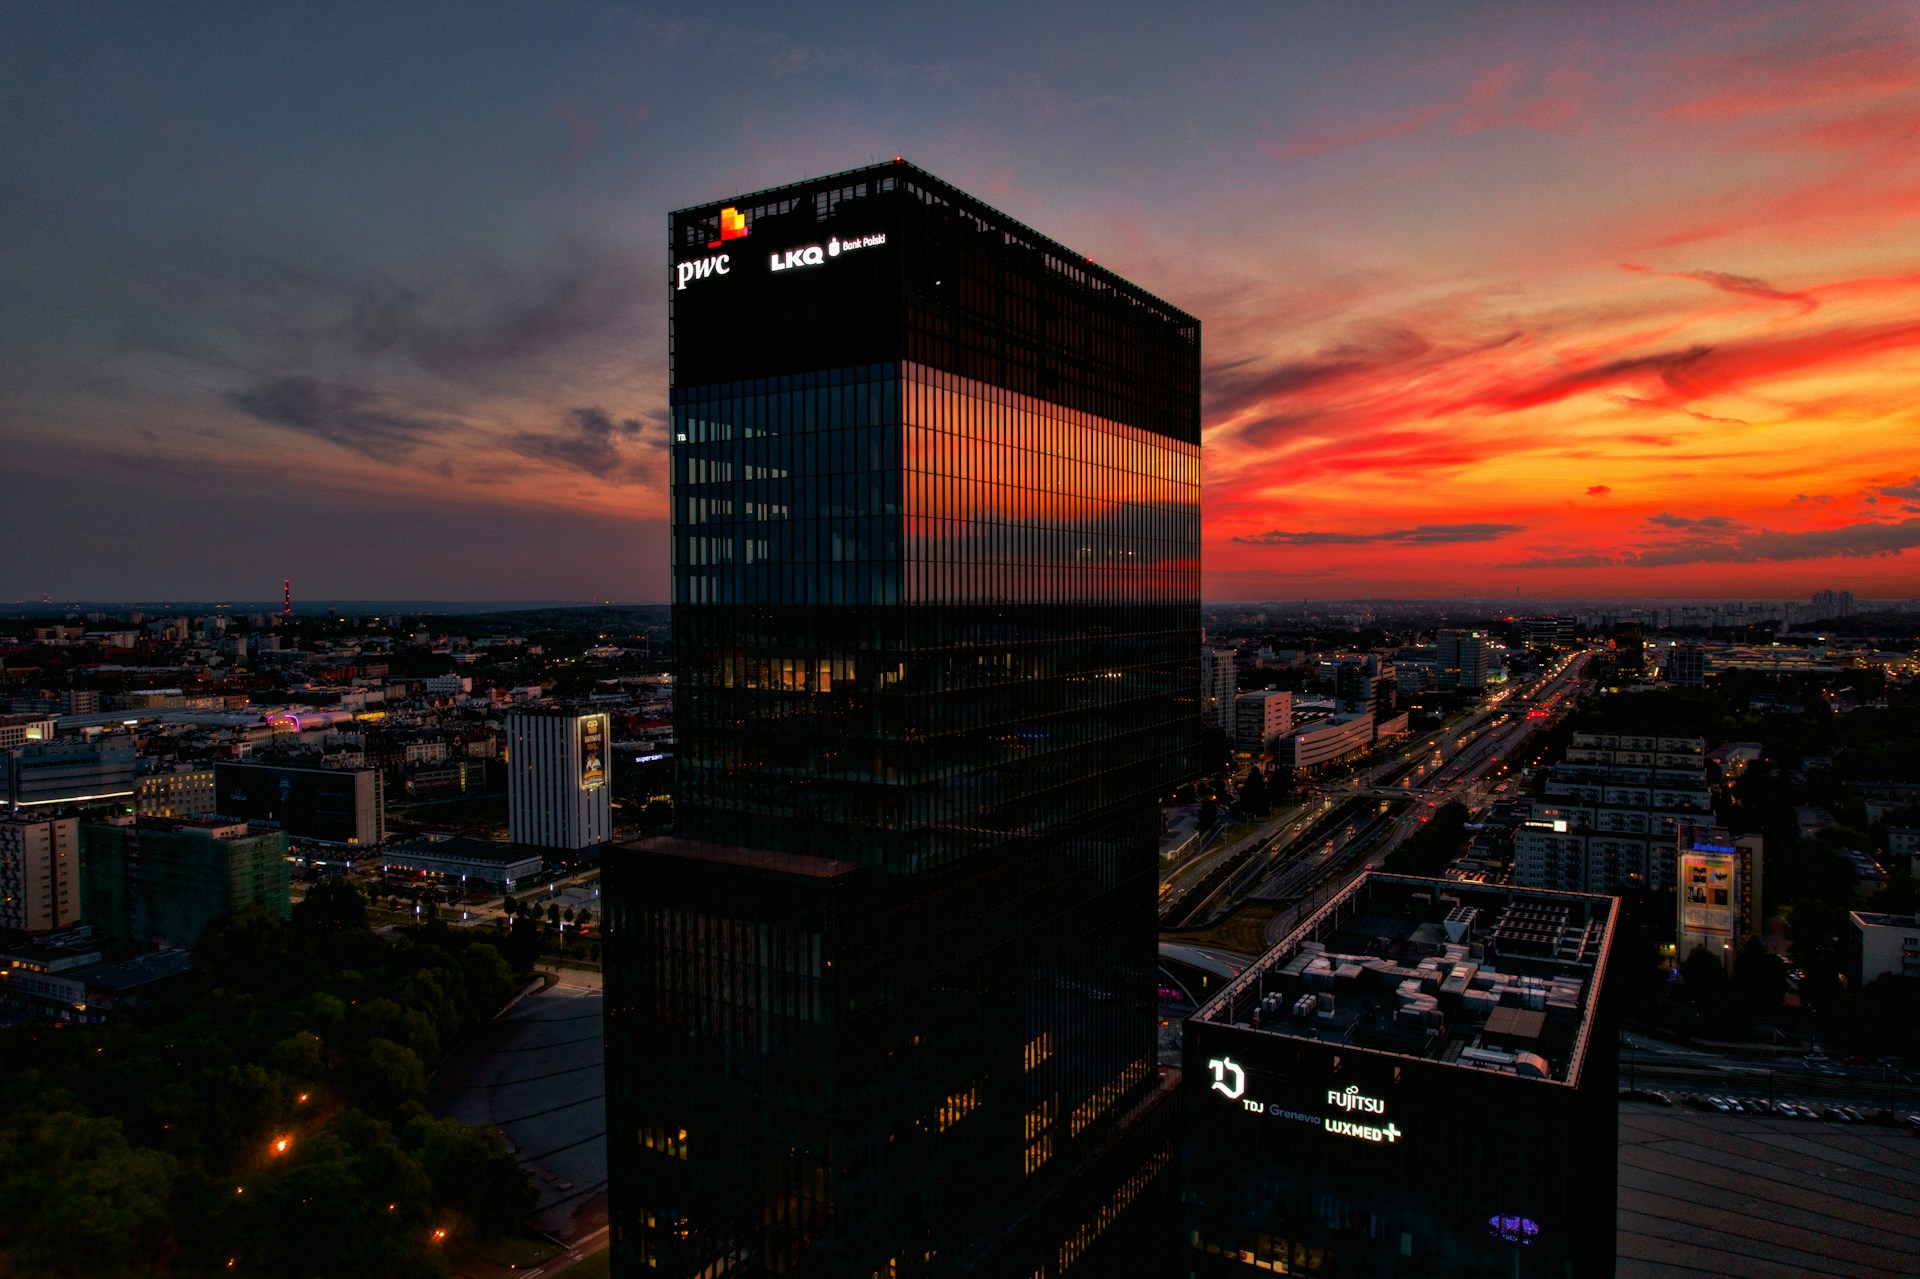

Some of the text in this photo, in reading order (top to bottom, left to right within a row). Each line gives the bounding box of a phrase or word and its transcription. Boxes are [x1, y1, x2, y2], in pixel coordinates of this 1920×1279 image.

[843, 234, 886, 251] Bank Polski
[771, 246, 824, 271] LKQ
[677, 254, 729, 290] pwc
[1243, 1099, 1263, 1113] TDJ
[1327, 1090, 1385, 1114] FUJITSU
[1269, 1104, 1321, 1125] Grenevia
